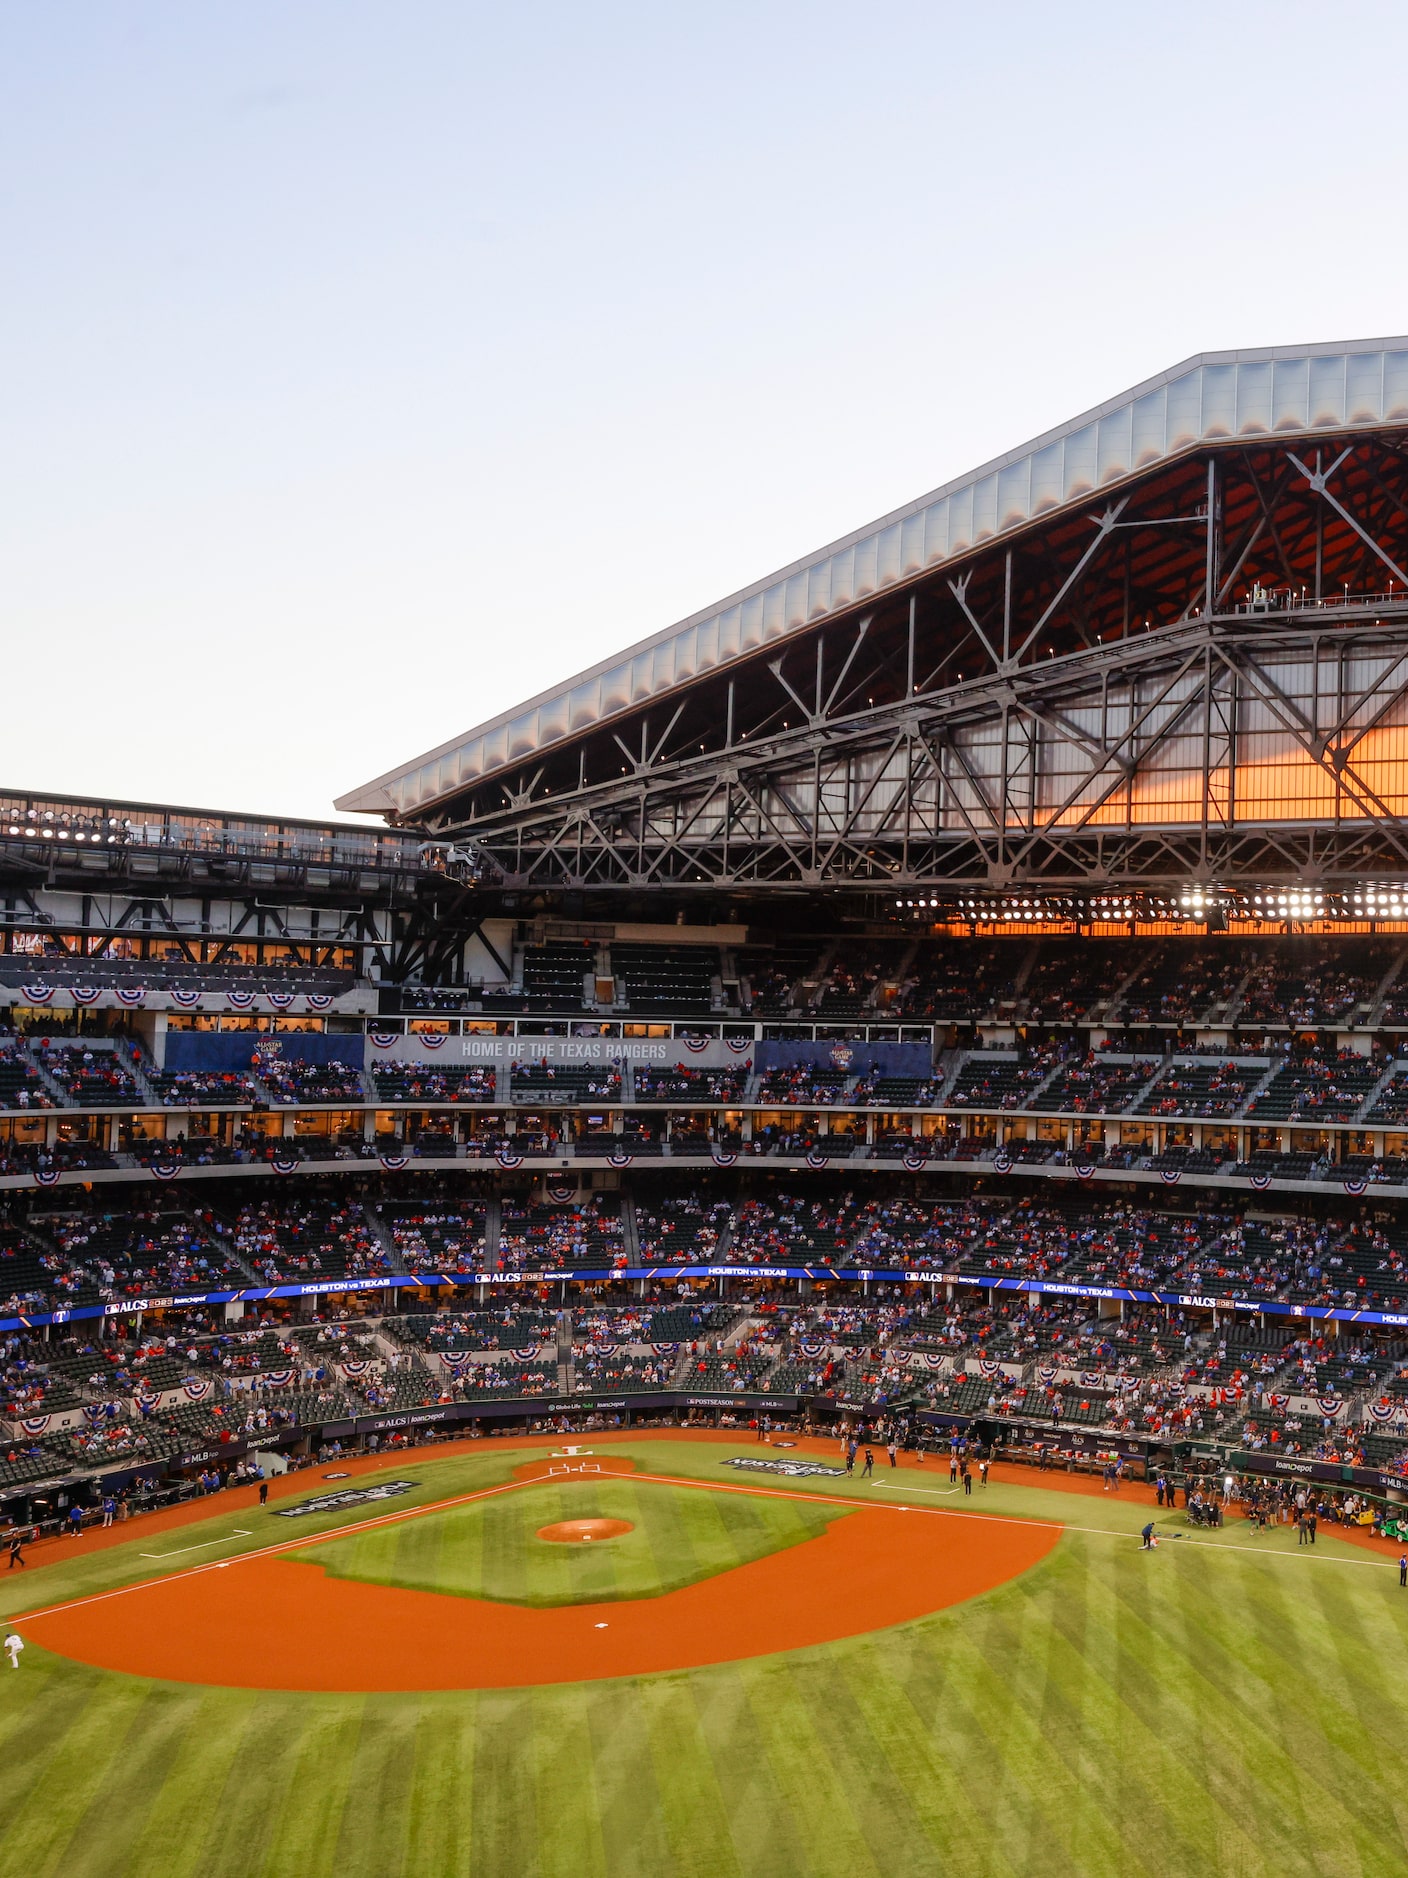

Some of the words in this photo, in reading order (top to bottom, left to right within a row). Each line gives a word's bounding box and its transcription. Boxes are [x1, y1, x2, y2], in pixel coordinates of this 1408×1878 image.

[462, 1042, 503, 1057] HOME
[508, 1043, 525, 1057] OF
[529, 1043, 555, 1057] THE
[559, 1043, 601, 1058] TEXAS
[605, 1044, 667, 1059] RANGERS
[491, 1273, 522, 1283] ALCS
[708, 1267, 750, 1275] HOUSTON
[758, 1268, 788, 1277] TEXAS
[919, 1272, 943, 1282] ALCS
[301, 1282, 348, 1294] HOUSTON
[359, 1279, 391, 1288] TEXAS
[1043, 1284, 1079, 1294] HOUSTON
[1087, 1287, 1113, 1298] TEXAS
[119, 1299, 148, 1313] ALCS
[1192, 1296, 1216, 1308] ALCS
[385, 1417, 407, 1428] ALCS
[246, 1434, 281, 1449] loanDepot
[191, 1451, 209, 1464] MLB
[1275, 1460, 1313, 1473] loanDepot
[1386, 1478, 1402, 1490] MLB
